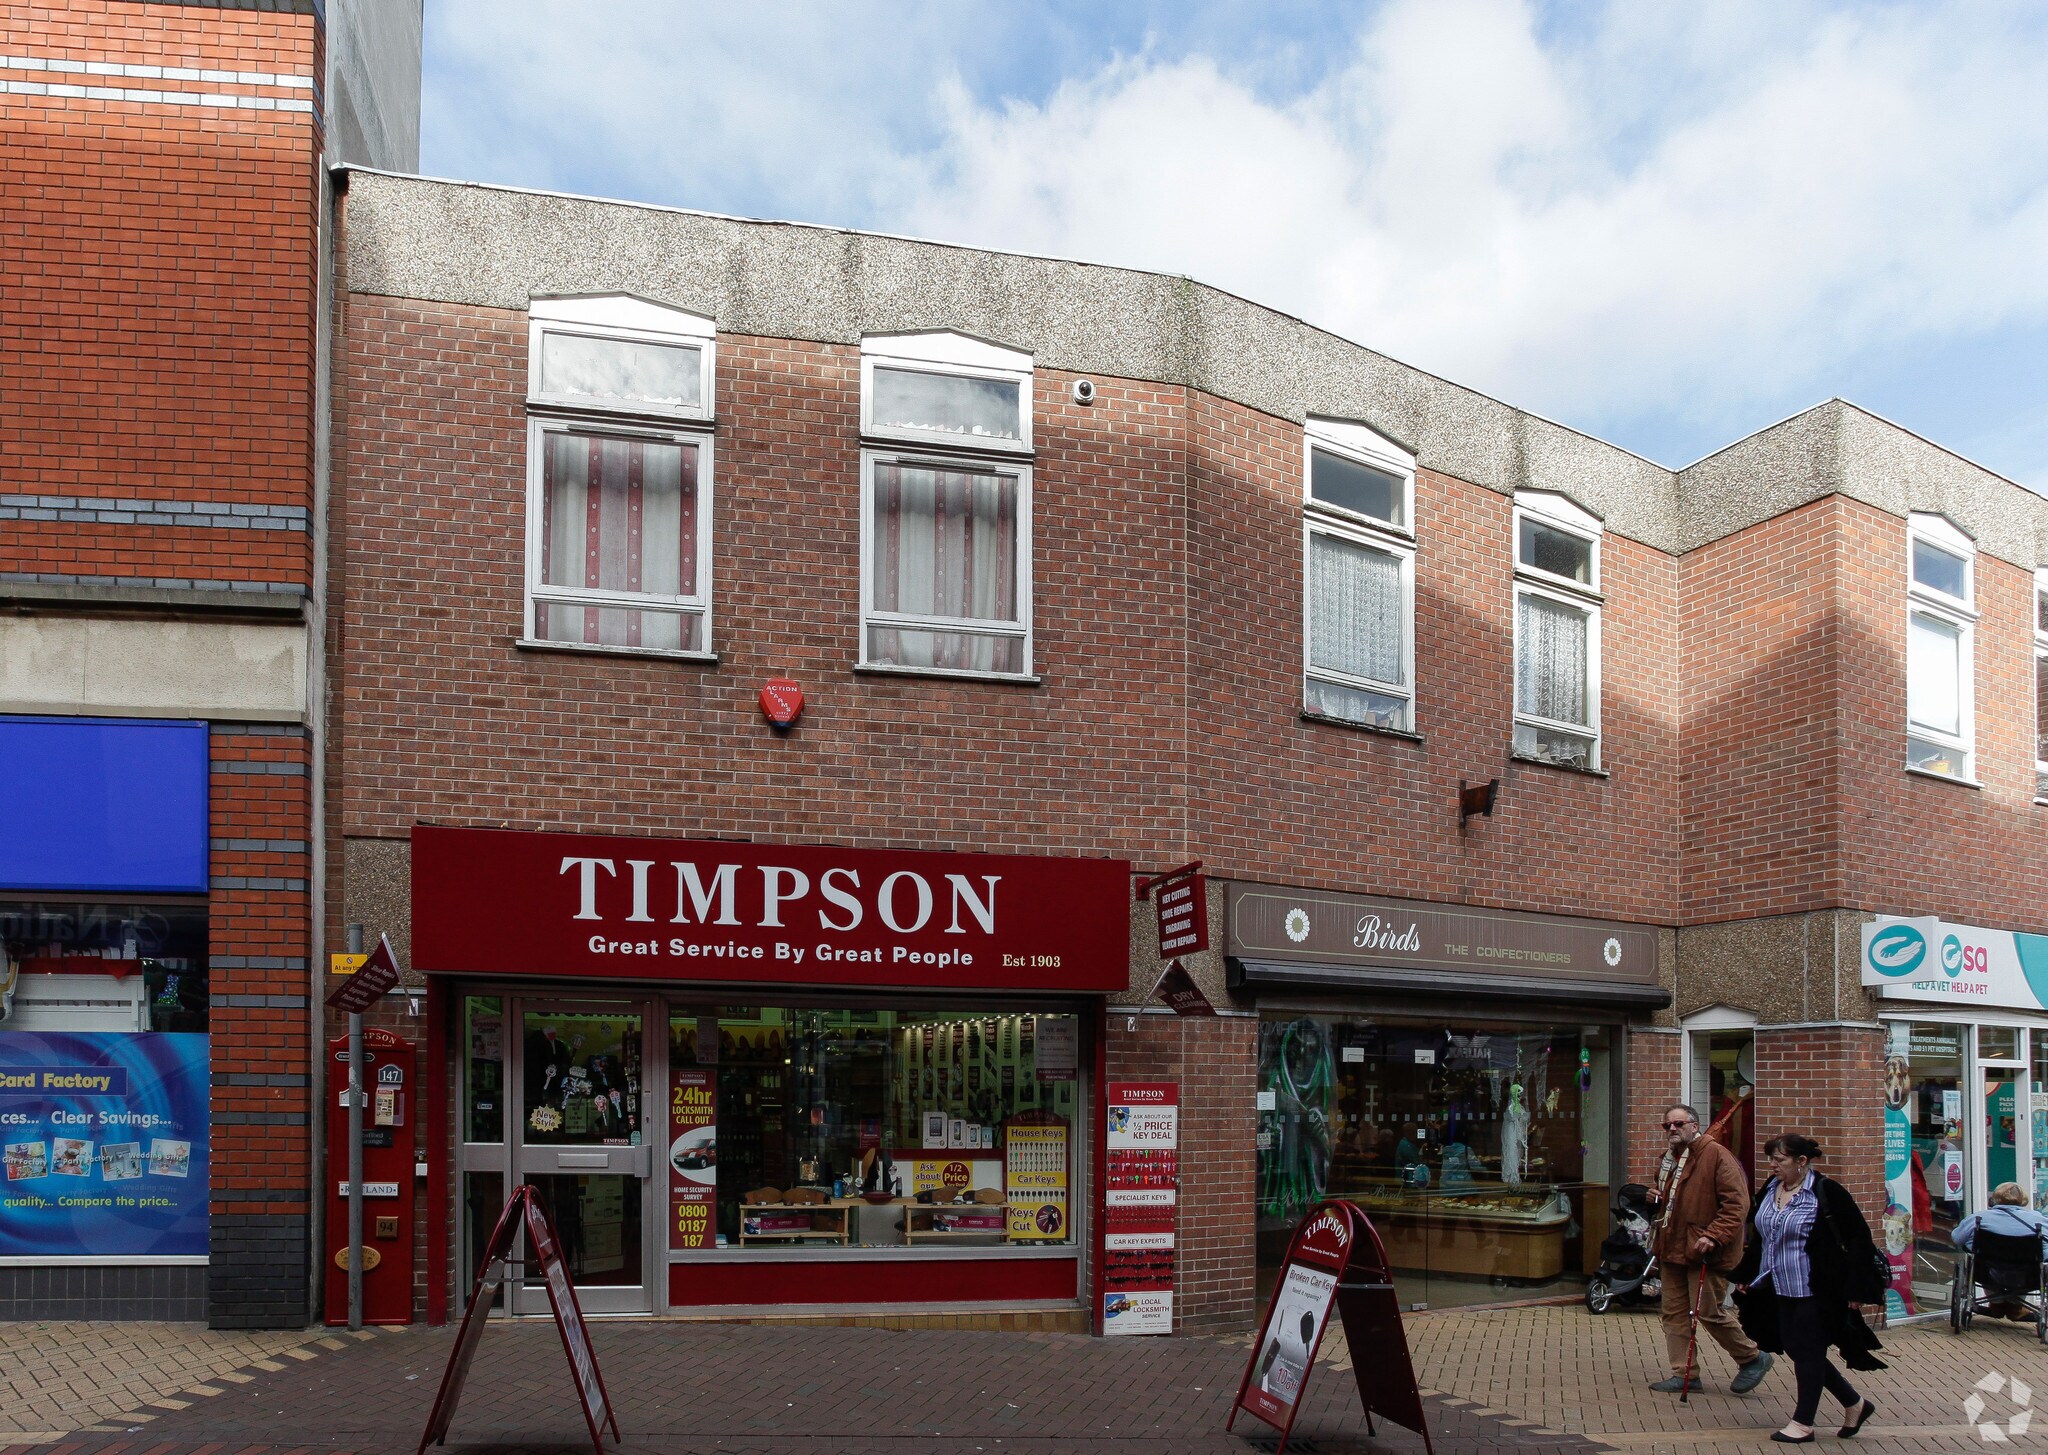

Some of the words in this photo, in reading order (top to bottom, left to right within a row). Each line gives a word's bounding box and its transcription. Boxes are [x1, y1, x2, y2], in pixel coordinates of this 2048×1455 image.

[559, 856, 1002, 934] TIMPSON
[1353, 914, 1420, 953] Birds
[588, 935, 659, 957] Great
[669, 938, 764, 959] Service
[775, 943, 805, 966] By
[815, 944, 883, 964] Great
[892, 947, 973, 970] People
[1002, 954, 1026, 967] Est
[1029, 955, 1061, 968] 1903
[1444, 943, 1469, 956] THE
[1476, 946, 1571, 964] CONFECTIONERS
[1937, 981, 1950, 992] VET
[1951, 981, 1969, 994] HELP
[1969, 984, 1975, 994] A
[1976, 984, 1988, 995] PET
[1172, 990, 1195, 1002] DRY
[382, 1070, 399, 1081] 147
[43, 1073, 111, 1091] Factory
[673, 1086, 712, 1105] 24hr
[1122, 1090, 1165, 1098] TIMPSON
[536, 1110, 557, 1120] New
[672, 1105, 714, 1115] LOCKSMITH
[51, 1110, 94, 1125] Clear
[98, 1110, 172, 1128] Savings...
[535, 1118, 556, 1127] Style
[676, 1115, 694, 1125] CALL
[695, 1115, 710, 1125] OUT
[1144, 1121, 1173, 1130] PRICE
[1011, 1128, 1040, 1138] House
[1042, 1128, 1063, 1139] Keys
[1133, 1131, 1149, 1140] KEY
[1151, 1131, 1172, 1140] DEAL
[1888, 1139, 1905, 1148] LIVES
[128, 1151, 162, 1160] Wedding
[919, 1162, 937, 1171] Ask
[949, 1164, 962, 1173] 1/2
[915, 1172, 941, 1181] about
[944, 1172, 968, 1182] Price
[1017, 1174, 1033, 1184] Car
[1035, 1174, 1056, 1186] Keys
[689, 1186, 713, 1194] SECURITY
[57, 1195, 112, 1209] Compare
[115, 1195, 136, 1206] the
[1114, 1193, 1149, 1201] SPECIALIST
[1150, 1193, 1168, 1201] KEYS
[678, 1205, 707, 1218] 0800
[1009, 1208, 1035, 1219] Keys
[379, 1221, 394, 1233] 94
[678, 1219, 707, 1232] 0187
[1012, 1220, 1032, 1231] Cut
[1304, 1216, 1348, 1248] TIMPSON
[682, 1234, 704, 1248] 187
[1113, 1237, 1127, 1245] CAR
[1127, 1237, 1140, 1245] KEY
[1140, 1237, 1167, 1245] EXPERTS
[1289, 1269, 1310, 1284] Broken
[1310, 1275, 1322, 1287] Car
[1322, 1278, 1334, 1293] Key
